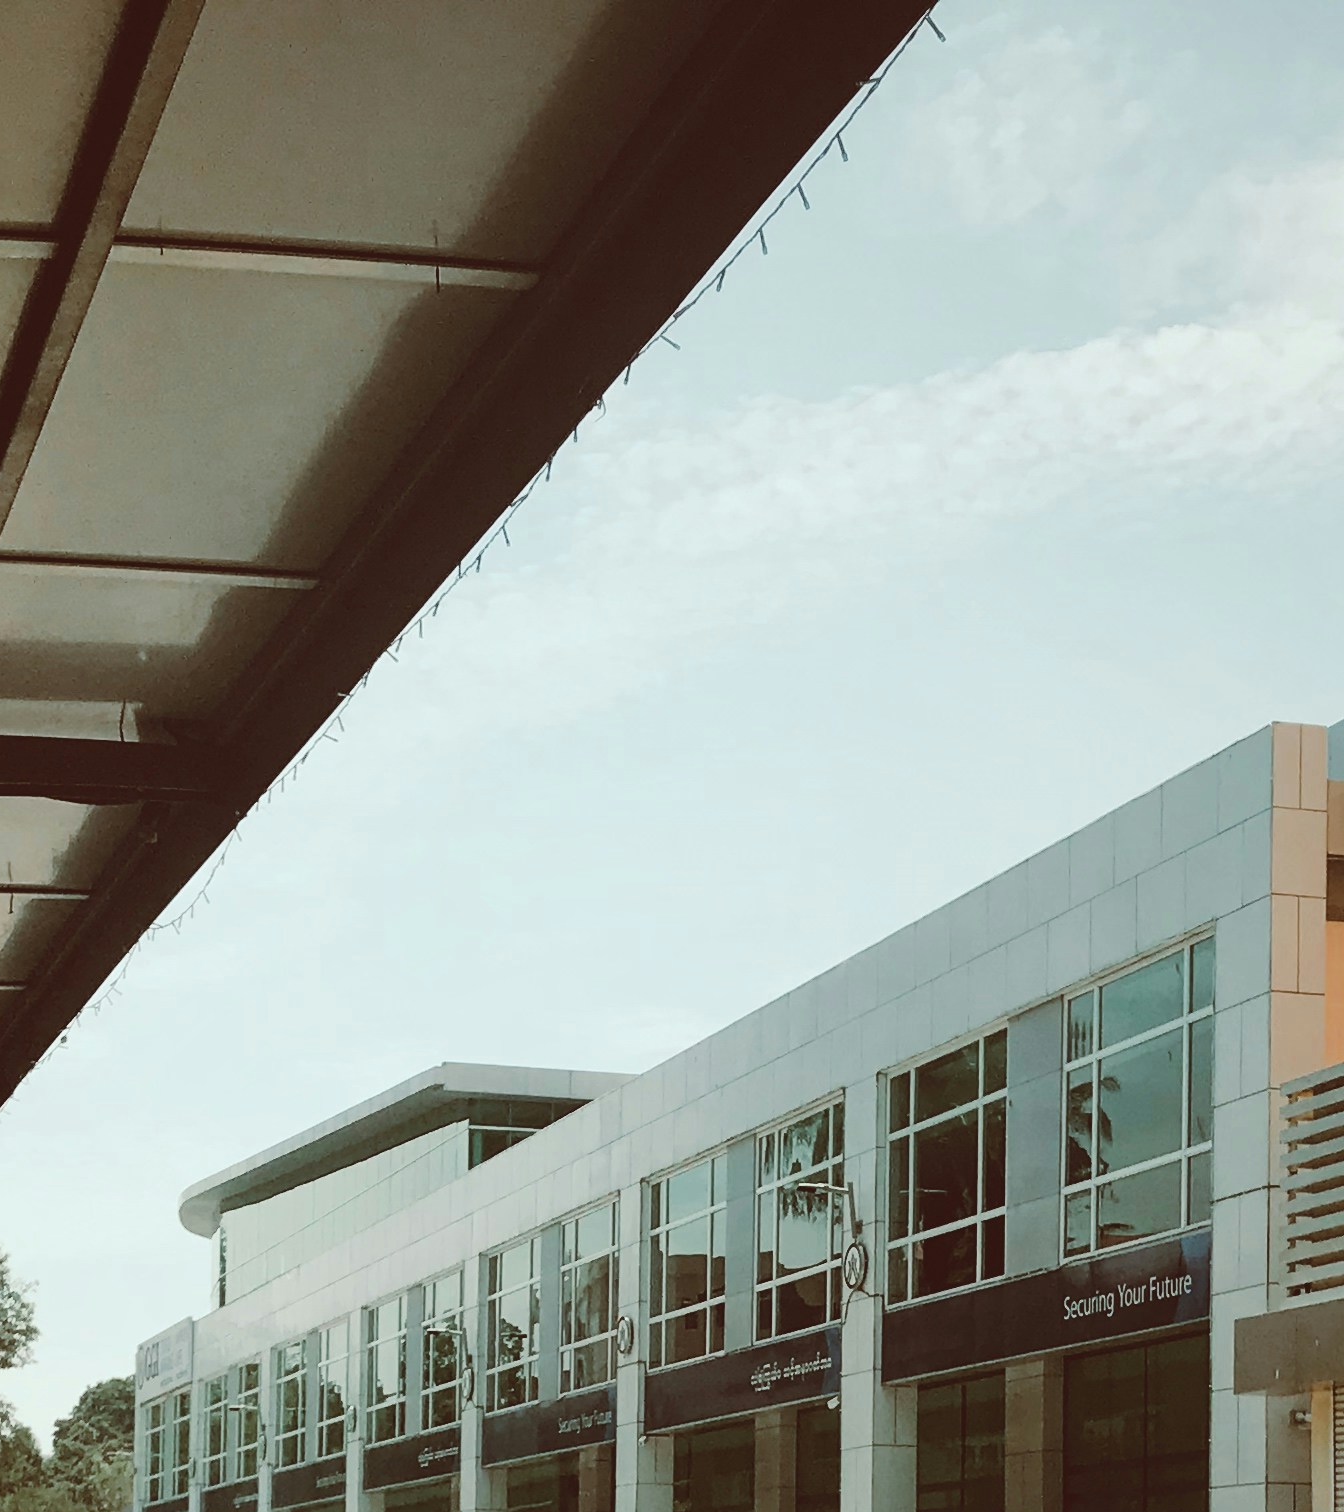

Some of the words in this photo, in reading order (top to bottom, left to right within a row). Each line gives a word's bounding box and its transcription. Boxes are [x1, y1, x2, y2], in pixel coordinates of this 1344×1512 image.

[1063, 1289, 1115, 1320] Securing
[1117, 1283, 1147, 1308] Your
[1149, 1274, 1193, 1302] Future
